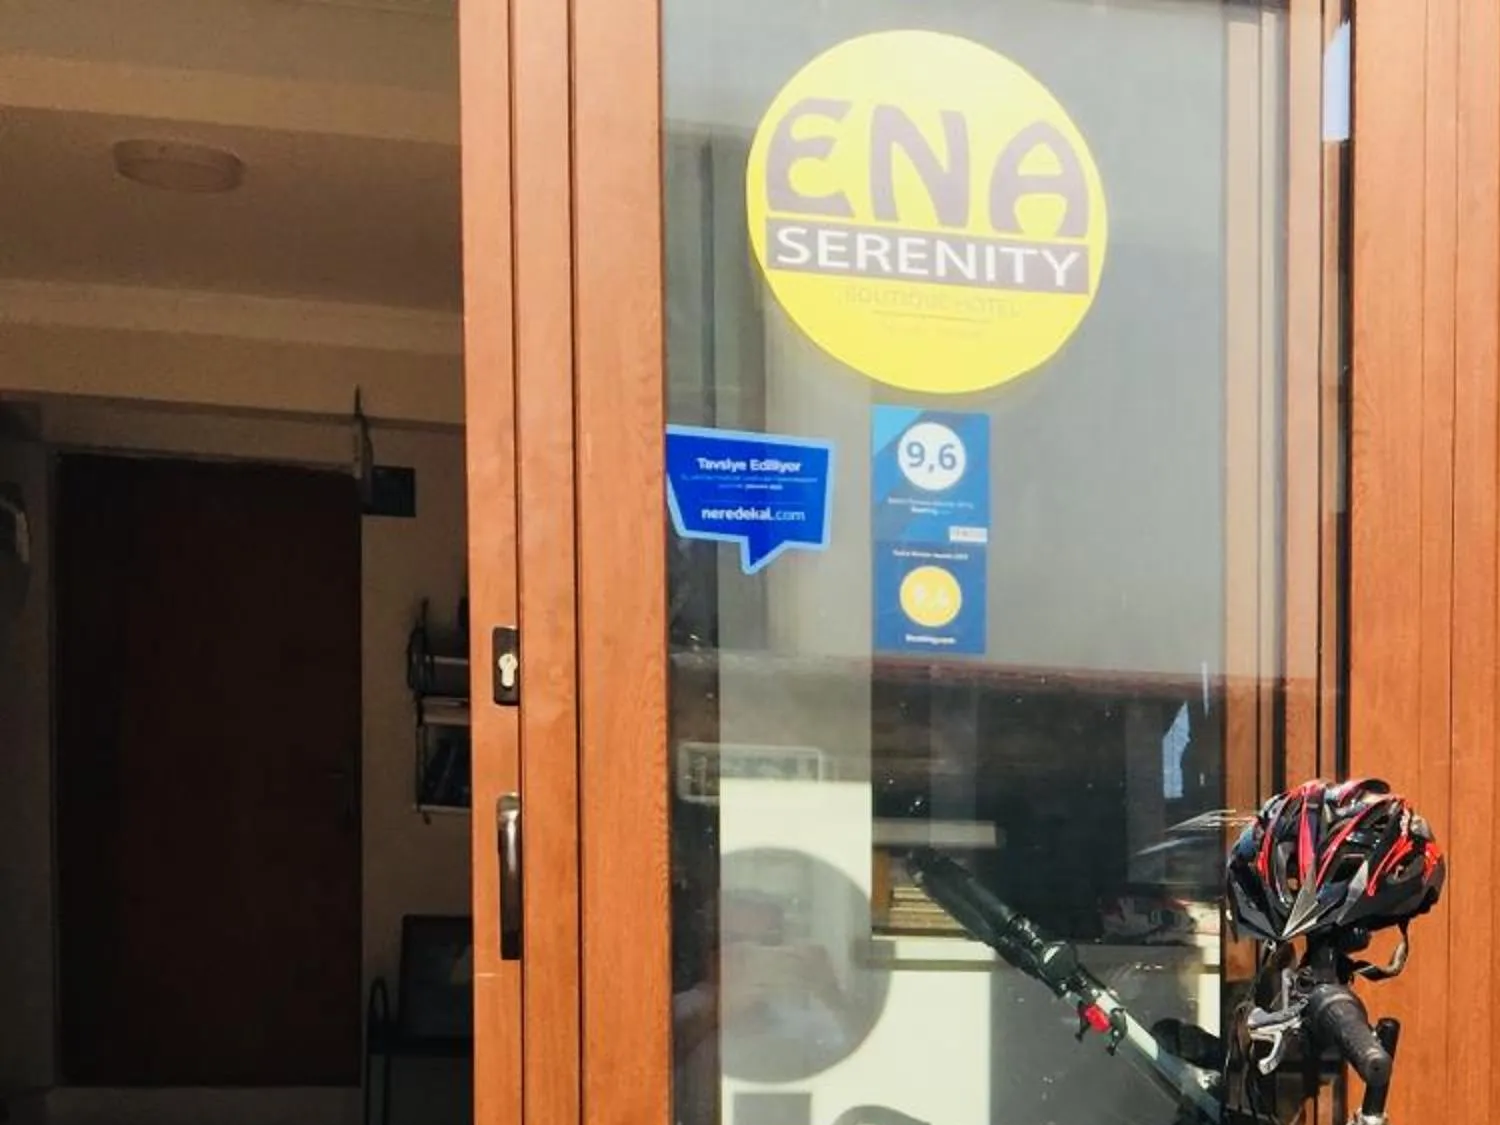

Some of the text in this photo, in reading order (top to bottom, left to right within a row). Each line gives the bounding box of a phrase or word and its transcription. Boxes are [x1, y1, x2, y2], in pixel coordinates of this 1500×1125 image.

[765, 96, 1090, 238] ENA
[776, 225, 1081, 287] SERENITY
[906, 441, 957, 473] 9,6
